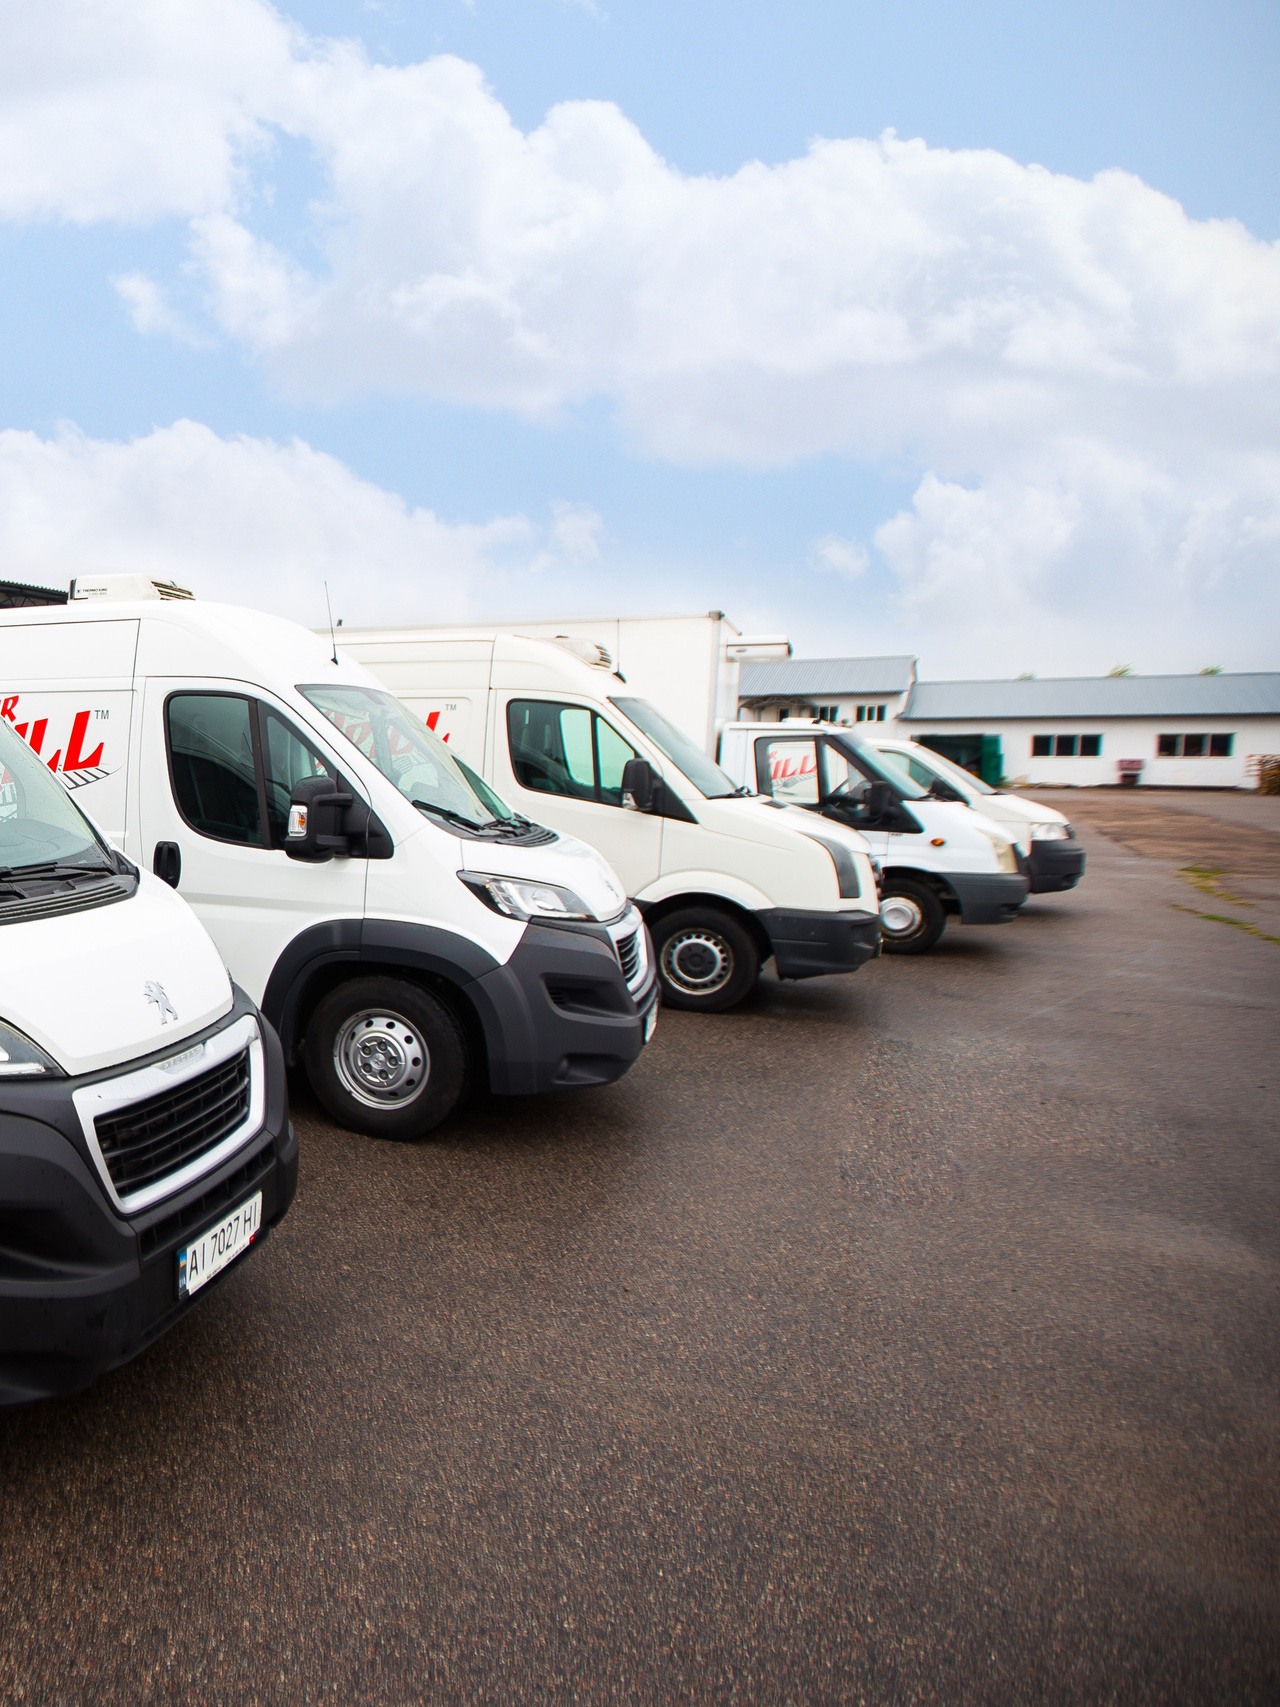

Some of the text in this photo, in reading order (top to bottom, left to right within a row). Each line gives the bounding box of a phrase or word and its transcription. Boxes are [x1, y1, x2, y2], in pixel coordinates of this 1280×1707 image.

[445, 703, 457, 711] TM
[94, 709, 110, 721] TM
[189, 1242, 206, 1282] AI
[210, 1215, 240, 1264] 7027
[243, 1201, 257, 1236] HI
